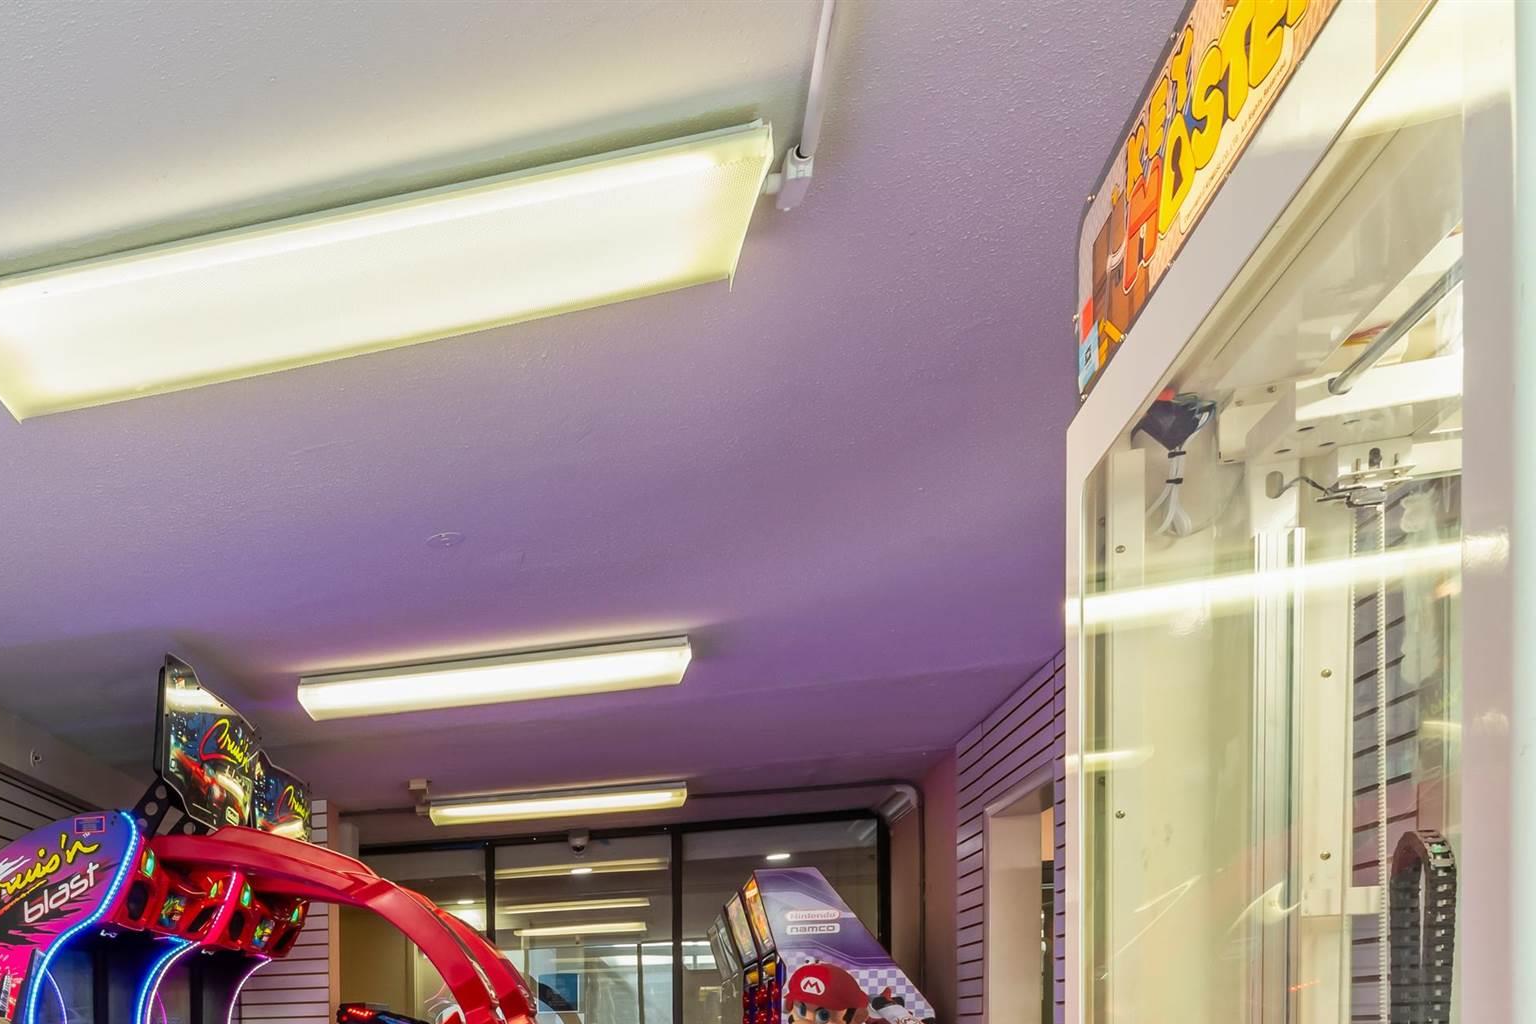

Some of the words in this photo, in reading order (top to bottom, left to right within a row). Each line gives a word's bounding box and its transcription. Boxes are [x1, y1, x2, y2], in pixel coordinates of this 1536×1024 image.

[1126, 26, 1194, 202] KEY
[23, 862, 100, 924] blast
[789, 911, 837, 920] Nintendo
[790, 925, 836, 933] namco
